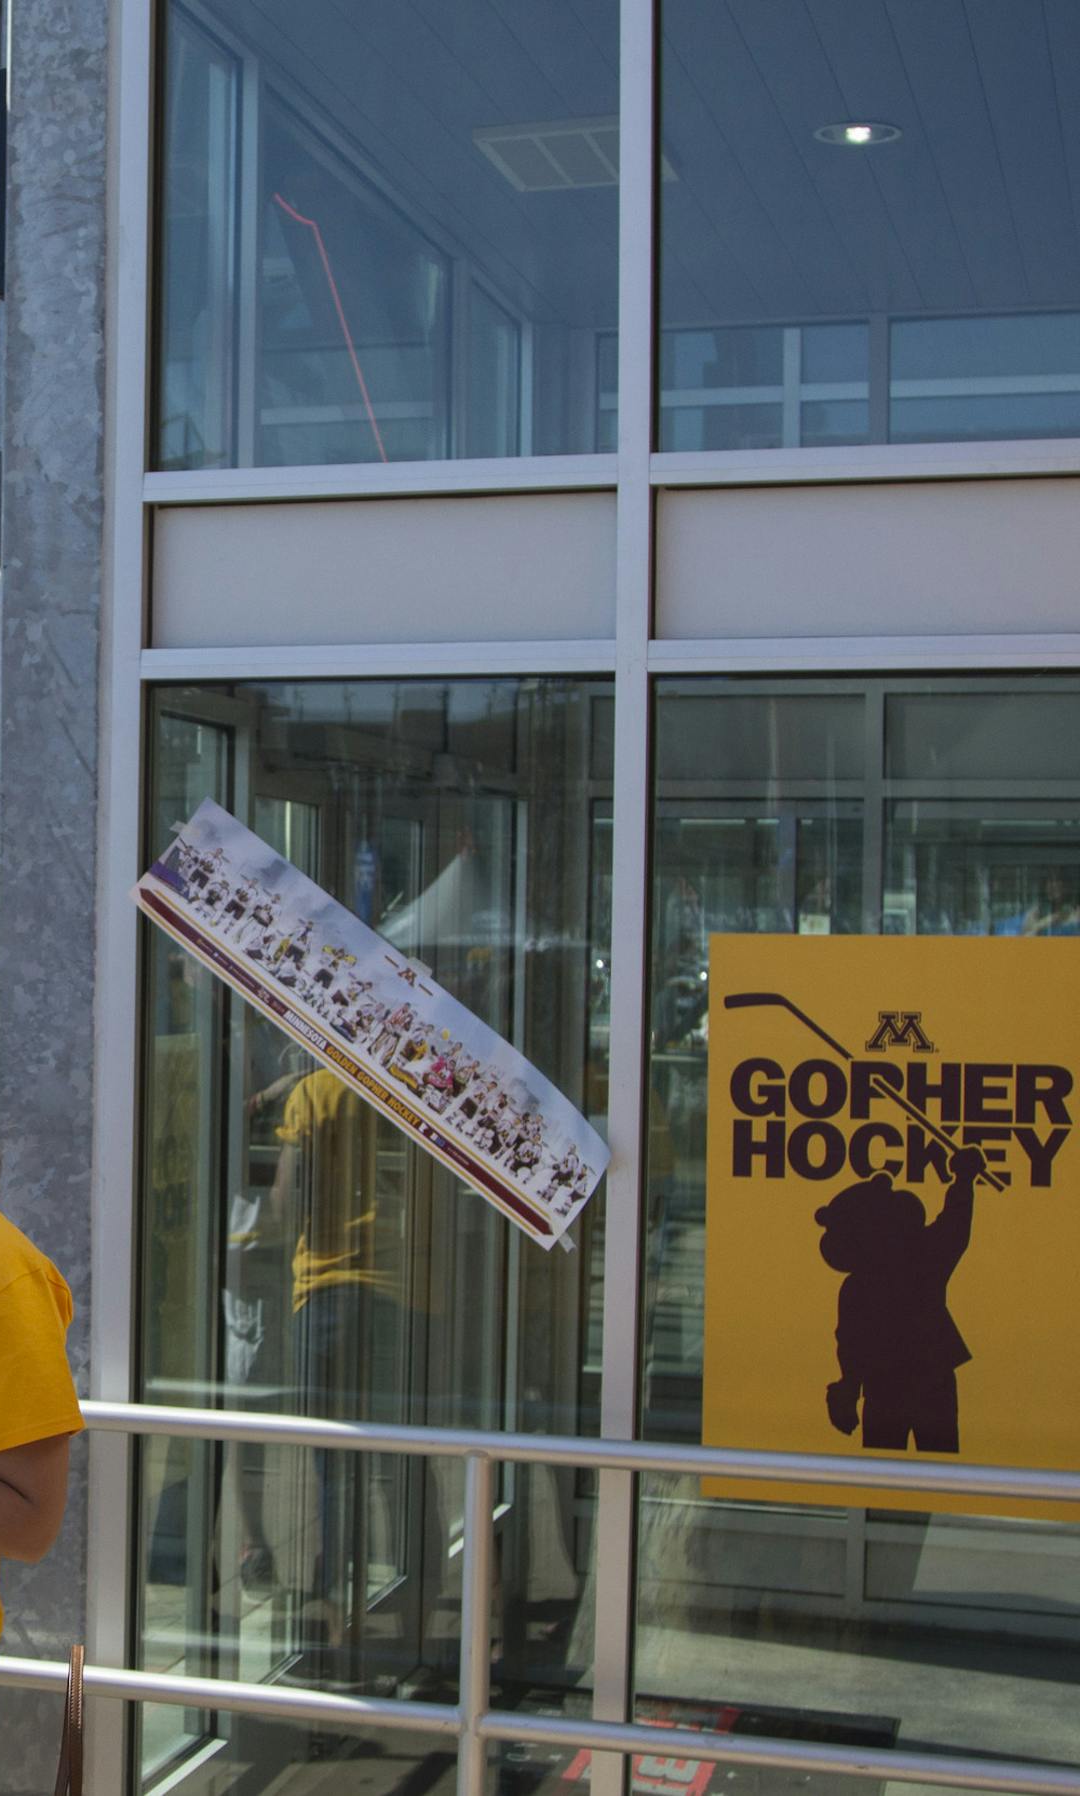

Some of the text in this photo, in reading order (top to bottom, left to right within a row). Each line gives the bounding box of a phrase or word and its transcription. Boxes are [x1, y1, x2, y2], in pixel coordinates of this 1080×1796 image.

[865, 1012, 935, 1053] M
[282, 1010, 420, 1127] MINNESOTA GOLDEN GOPHER HOCKEY
[730, 1057, 1074, 1125] GOPHER
[732, 1119, 1072, 1188] HOCKEY
